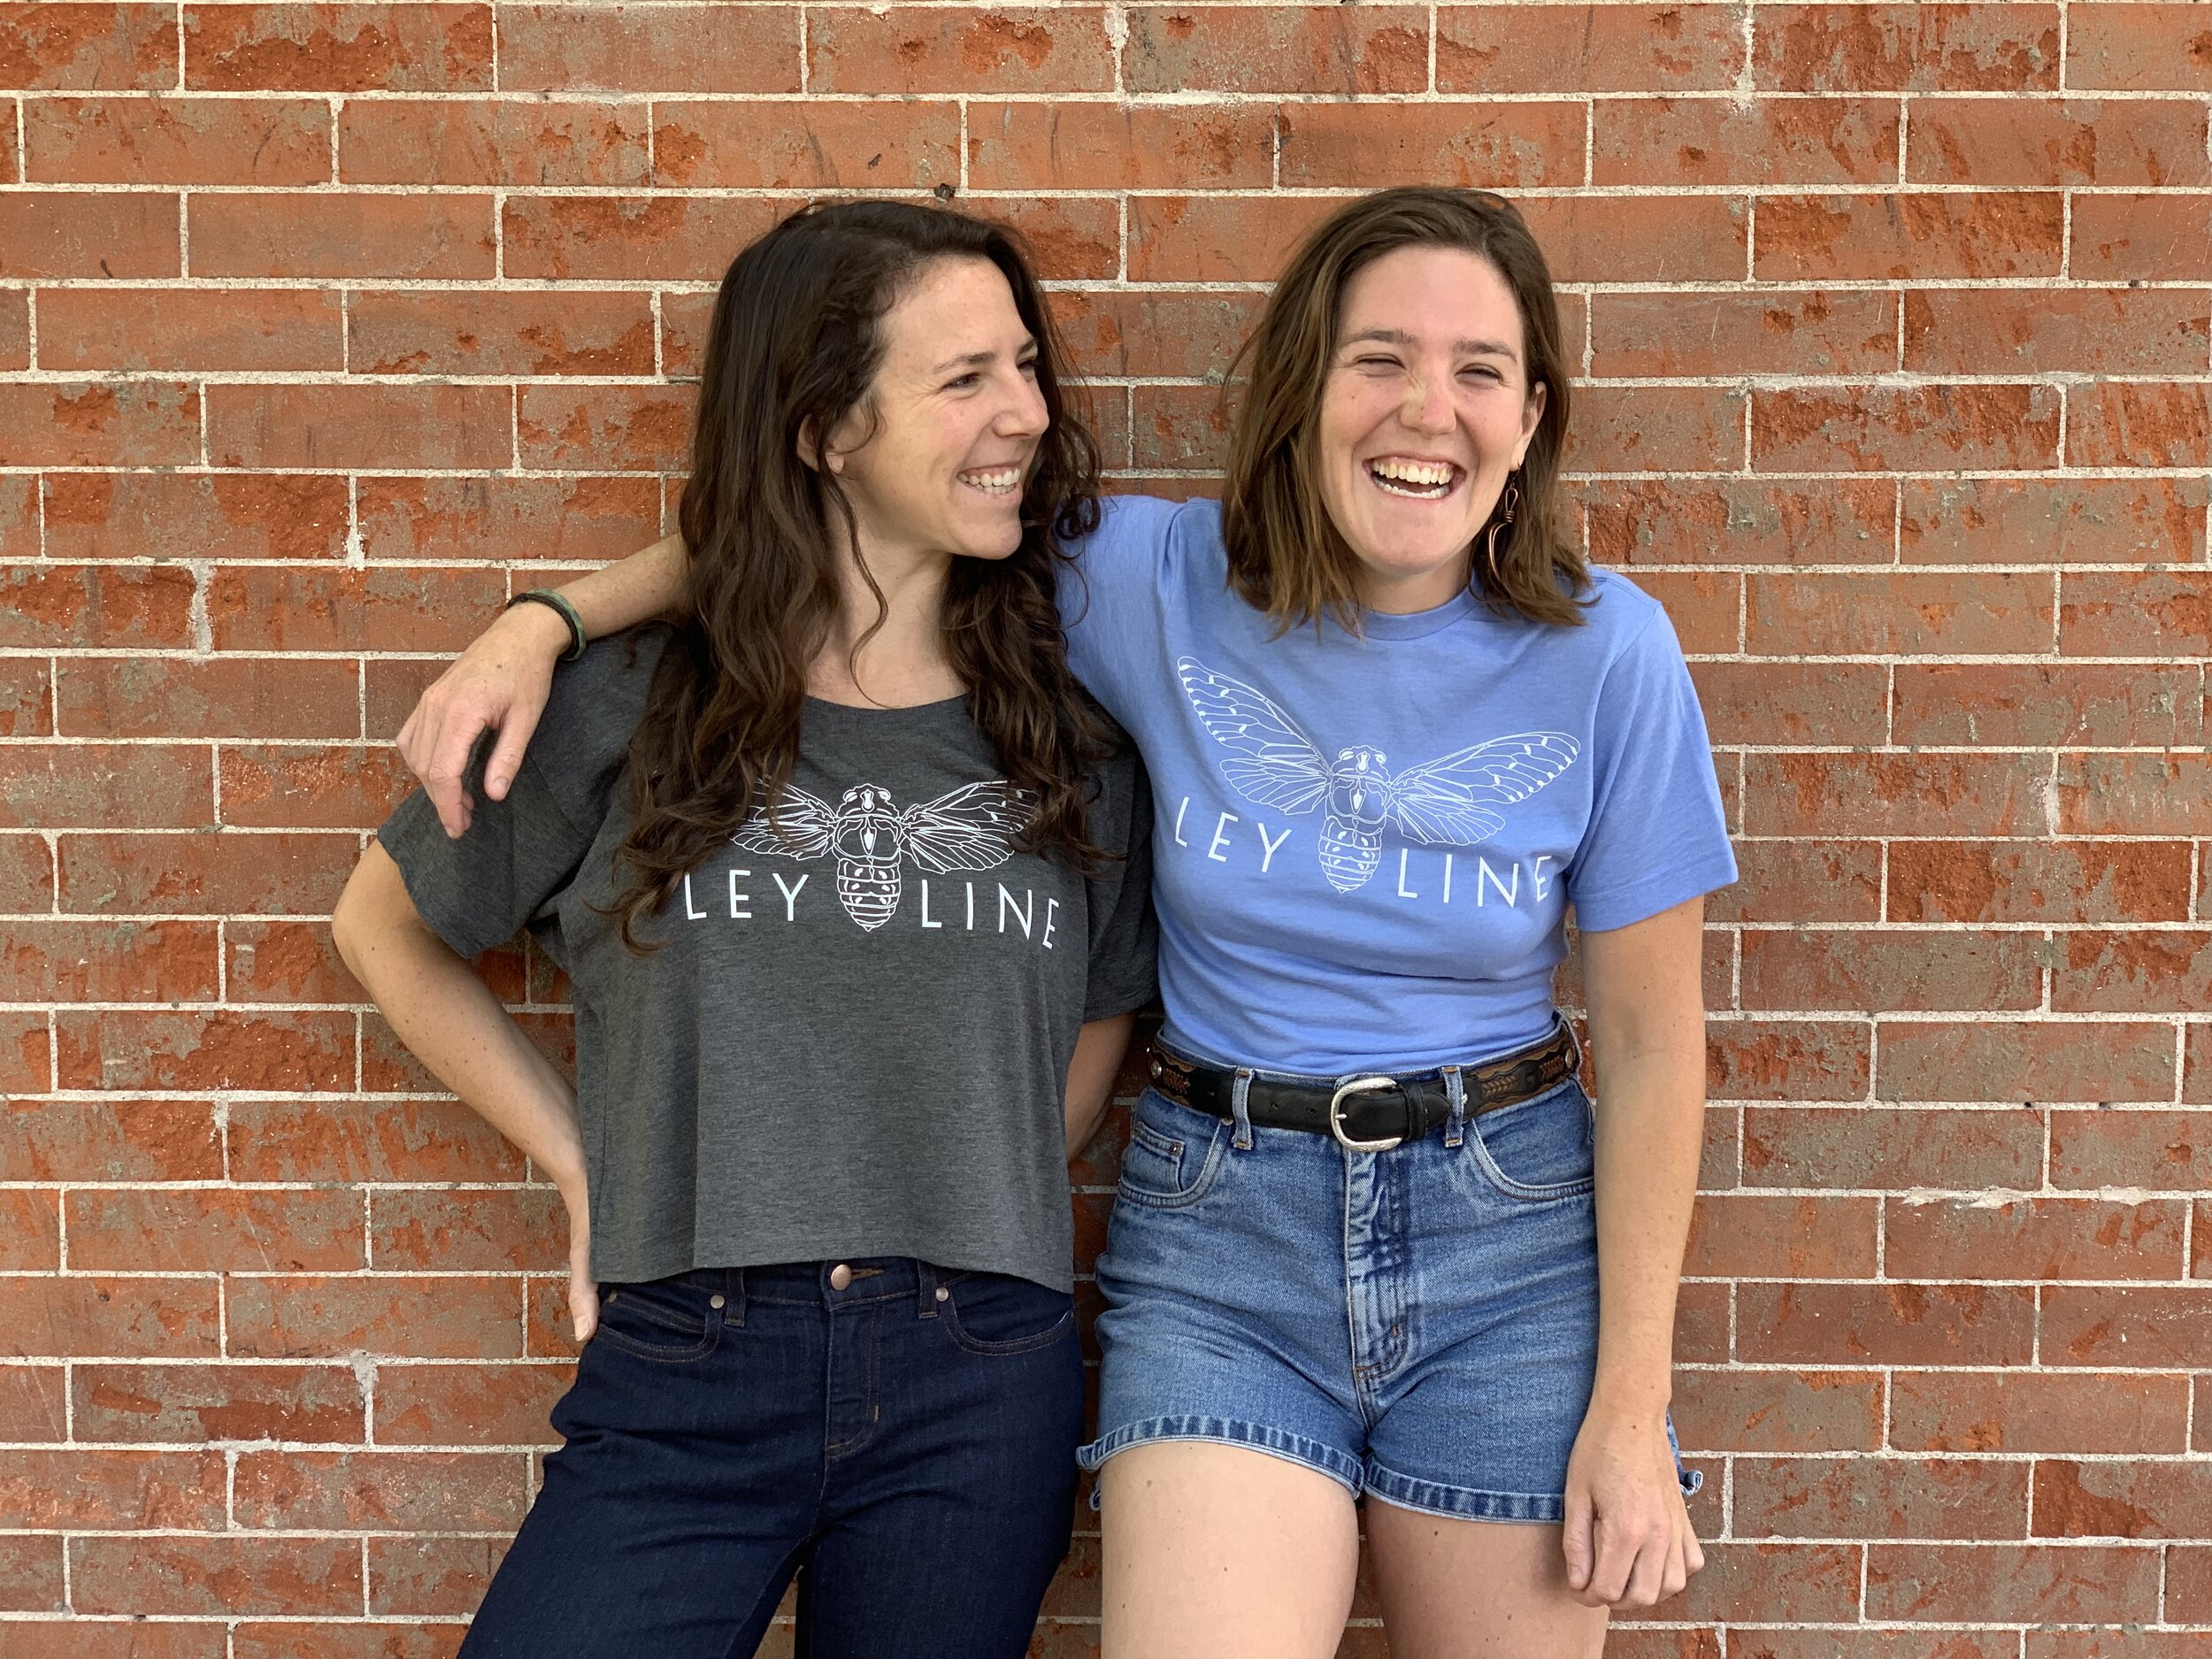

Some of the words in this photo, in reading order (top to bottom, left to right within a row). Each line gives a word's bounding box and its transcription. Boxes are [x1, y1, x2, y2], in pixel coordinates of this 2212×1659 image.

[1174, 796, 1292, 872] LEY
[1397, 848, 1552, 908] LINE
[684, 869, 809, 922] LEY
[921, 879, 1060, 949] LINE
